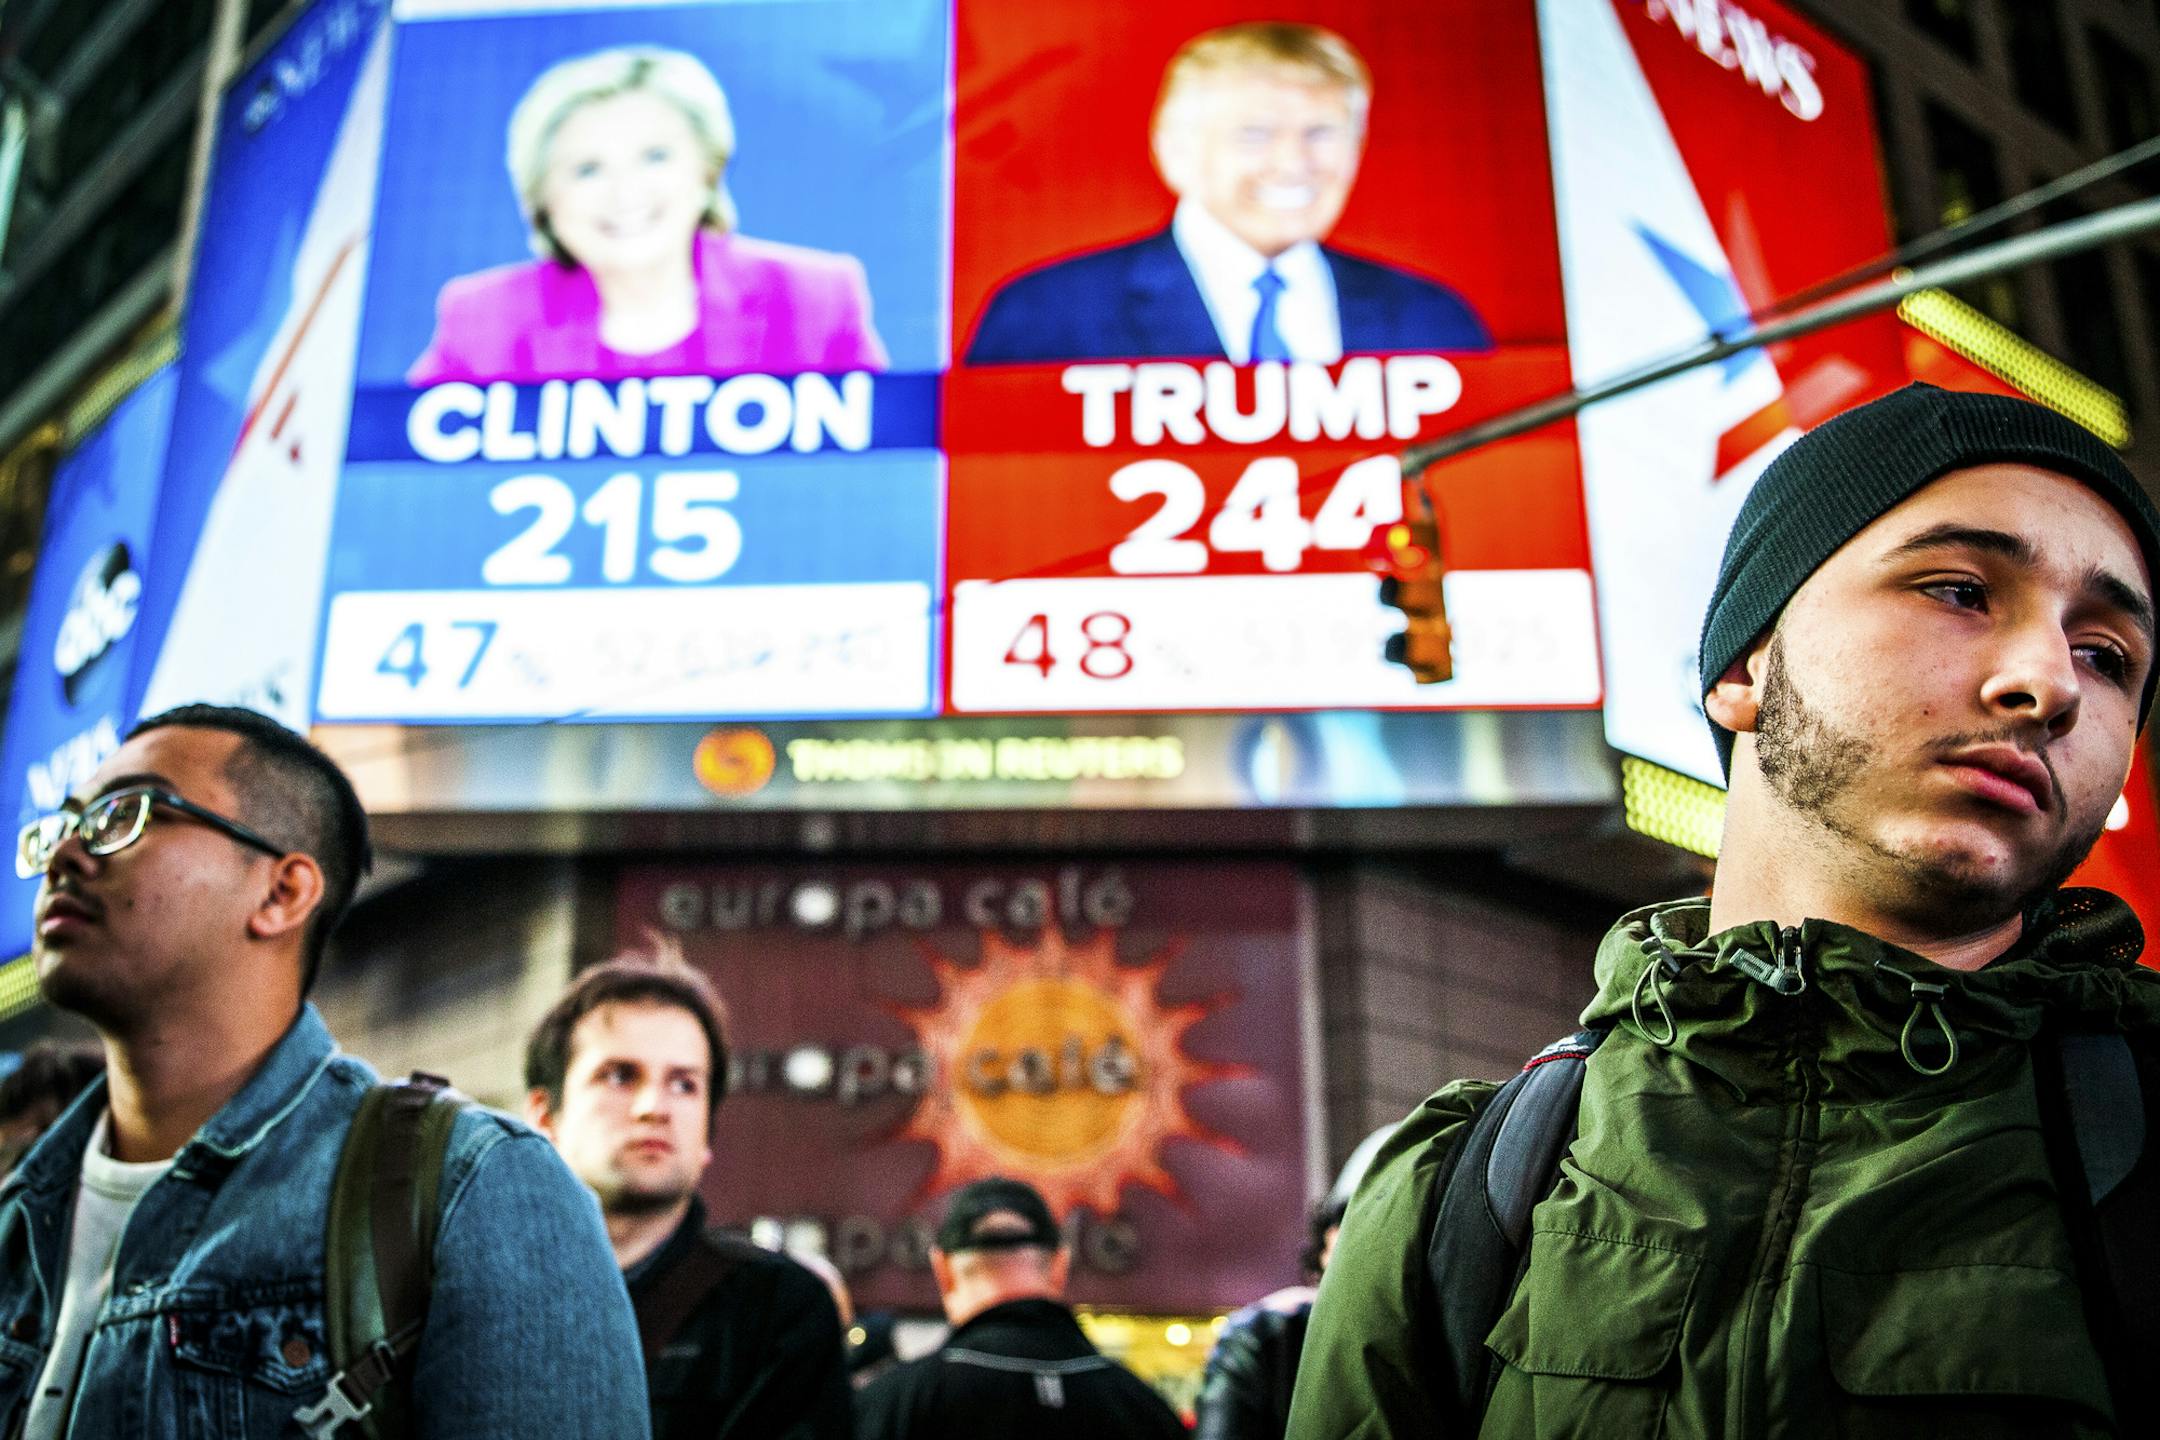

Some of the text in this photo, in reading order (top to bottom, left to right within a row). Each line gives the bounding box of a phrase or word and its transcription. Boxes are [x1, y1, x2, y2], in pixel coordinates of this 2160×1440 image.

[407, 371, 875, 463] CLINTON
[1062, 355, 1462, 447] TRUMP
[482, 470, 743, 586] 215
[1109, 455, 1404, 576] 244
[660, 879, 944, 940] europa
[727, 1043, 936, 1105] ropa
